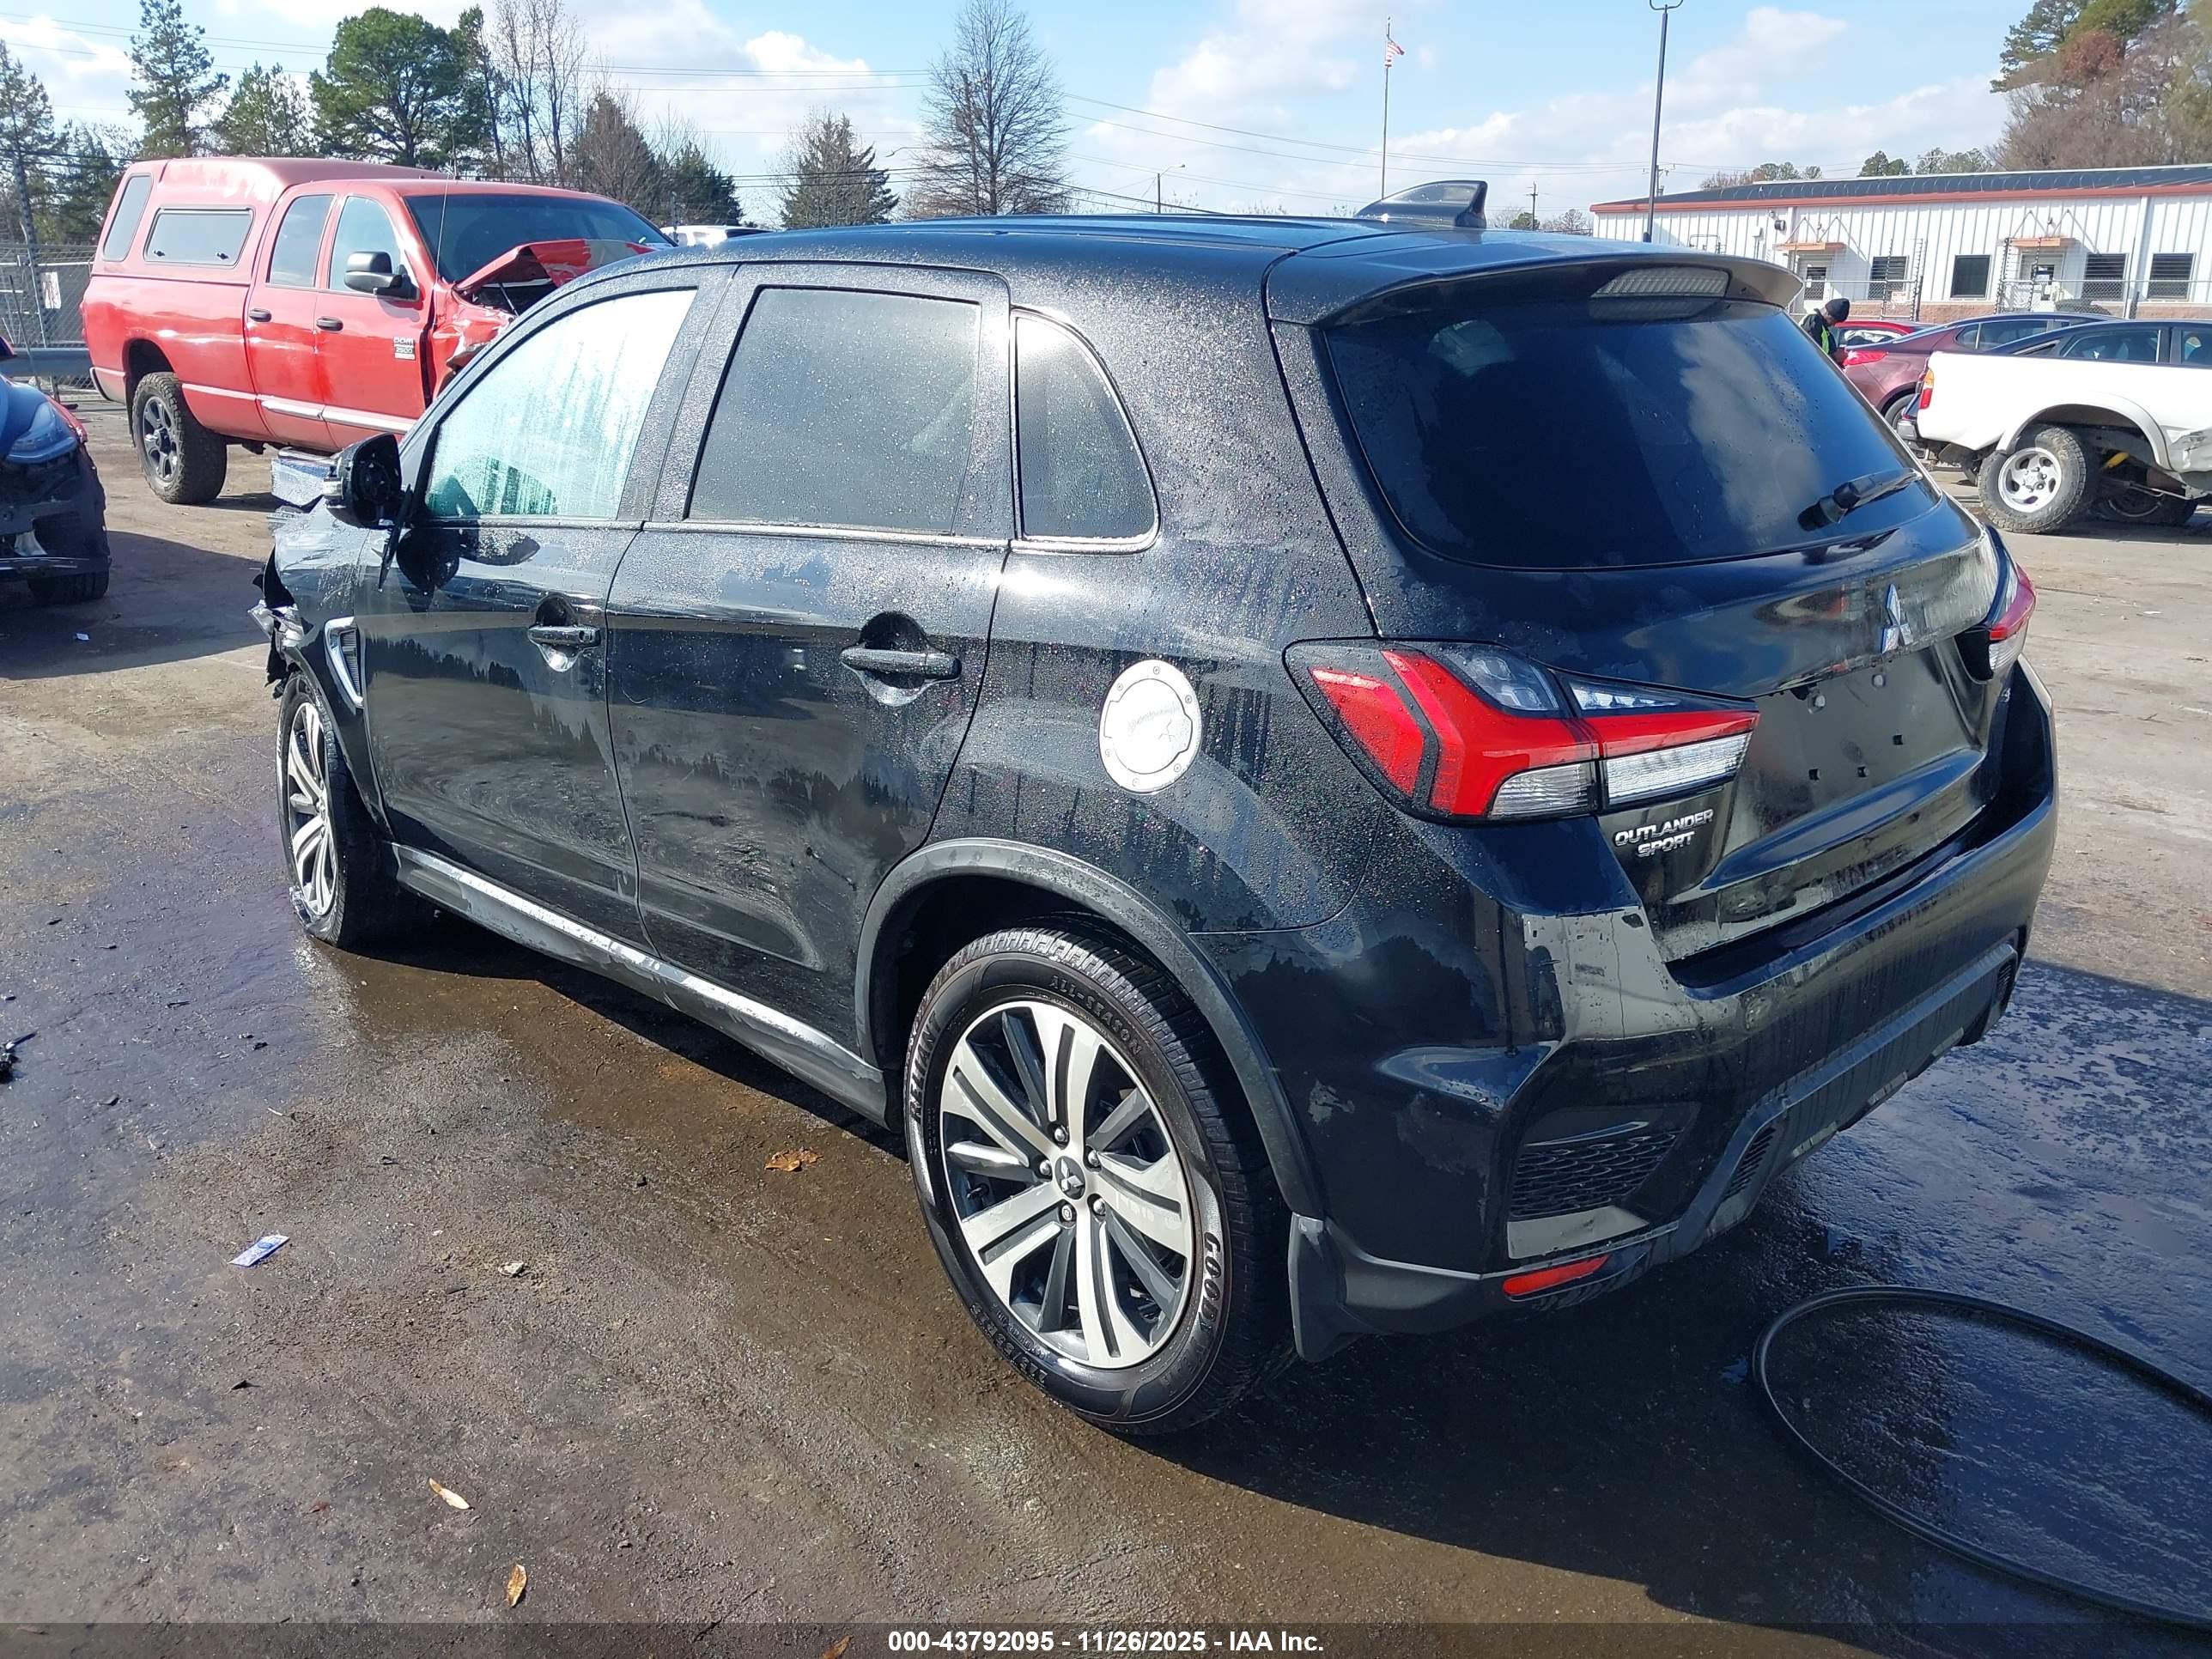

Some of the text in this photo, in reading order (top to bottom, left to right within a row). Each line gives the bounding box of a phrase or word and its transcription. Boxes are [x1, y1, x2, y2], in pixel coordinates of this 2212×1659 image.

[1614, 809, 1714, 847] OUTLANDER
[1637, 830, 1695, 858] SPORT
[1048, 975, 1142, 1056] ALL-SEASON
[909, 1010, 941, 1126] RELIANT
